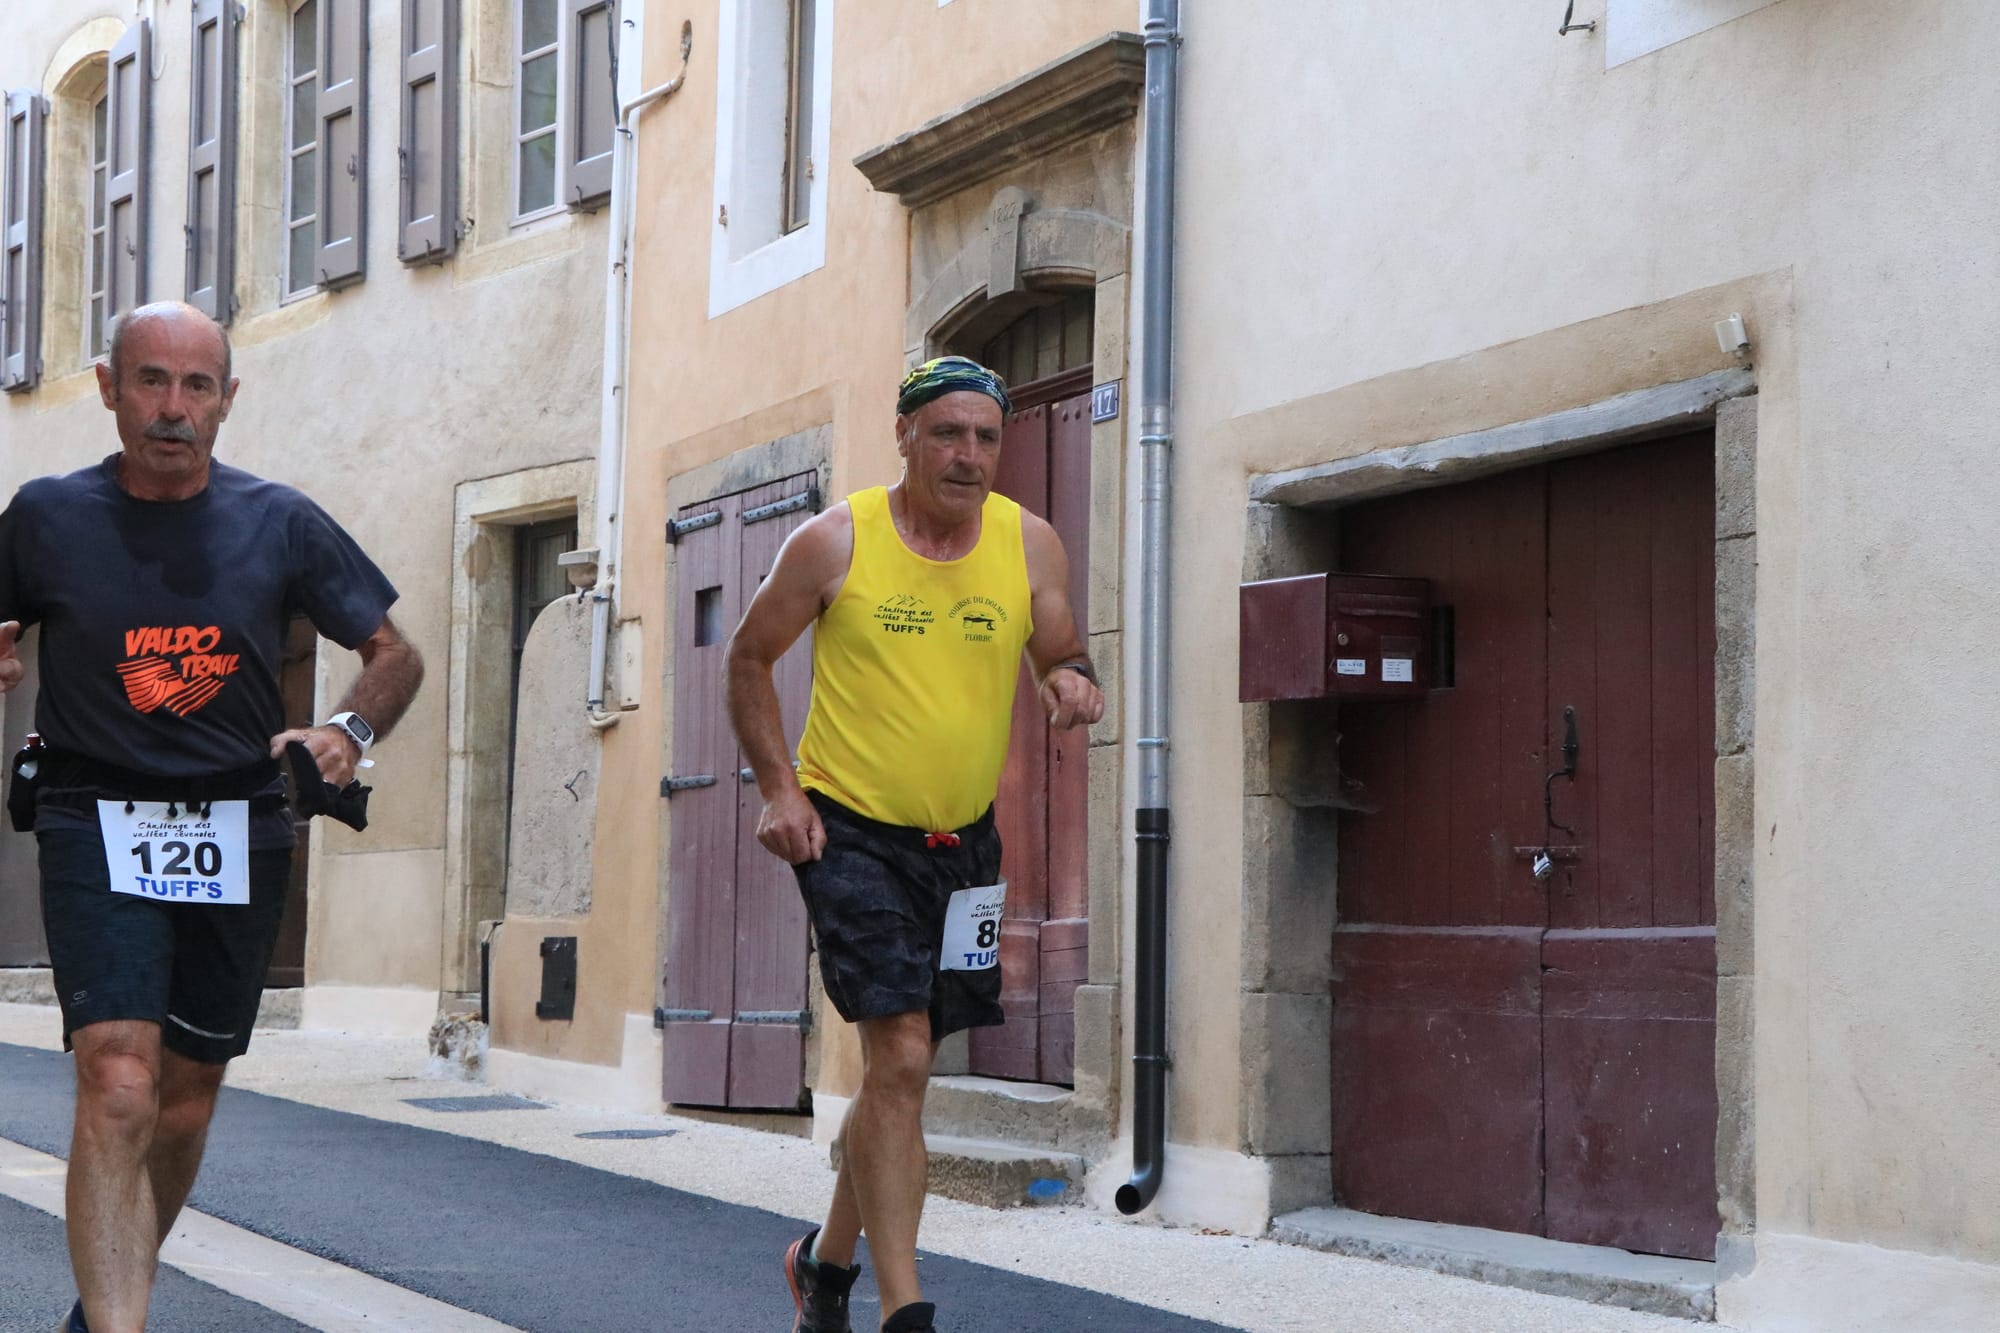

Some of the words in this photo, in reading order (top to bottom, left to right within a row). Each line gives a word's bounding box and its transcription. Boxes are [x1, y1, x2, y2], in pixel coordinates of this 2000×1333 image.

[1097, 389, 1112, 415] 17
[877, 605, 916, 617] Challenge
[948, 597, 972, 619] COURSE
[883, 623, 925, 634] TUFF'S
[126, 626, 221, 657] VALDO
[180, 654, 240, 679] TRAIL
[133, 830, 168, 838] vallées
[174, 829, 217, 838] cévenoles
[137, 822, 188, 832] Challenge
[131, 841, 222, 877] 120
[135, 876, 222, 899] TUFF'S
[976, 919, 1001, 948] 8
